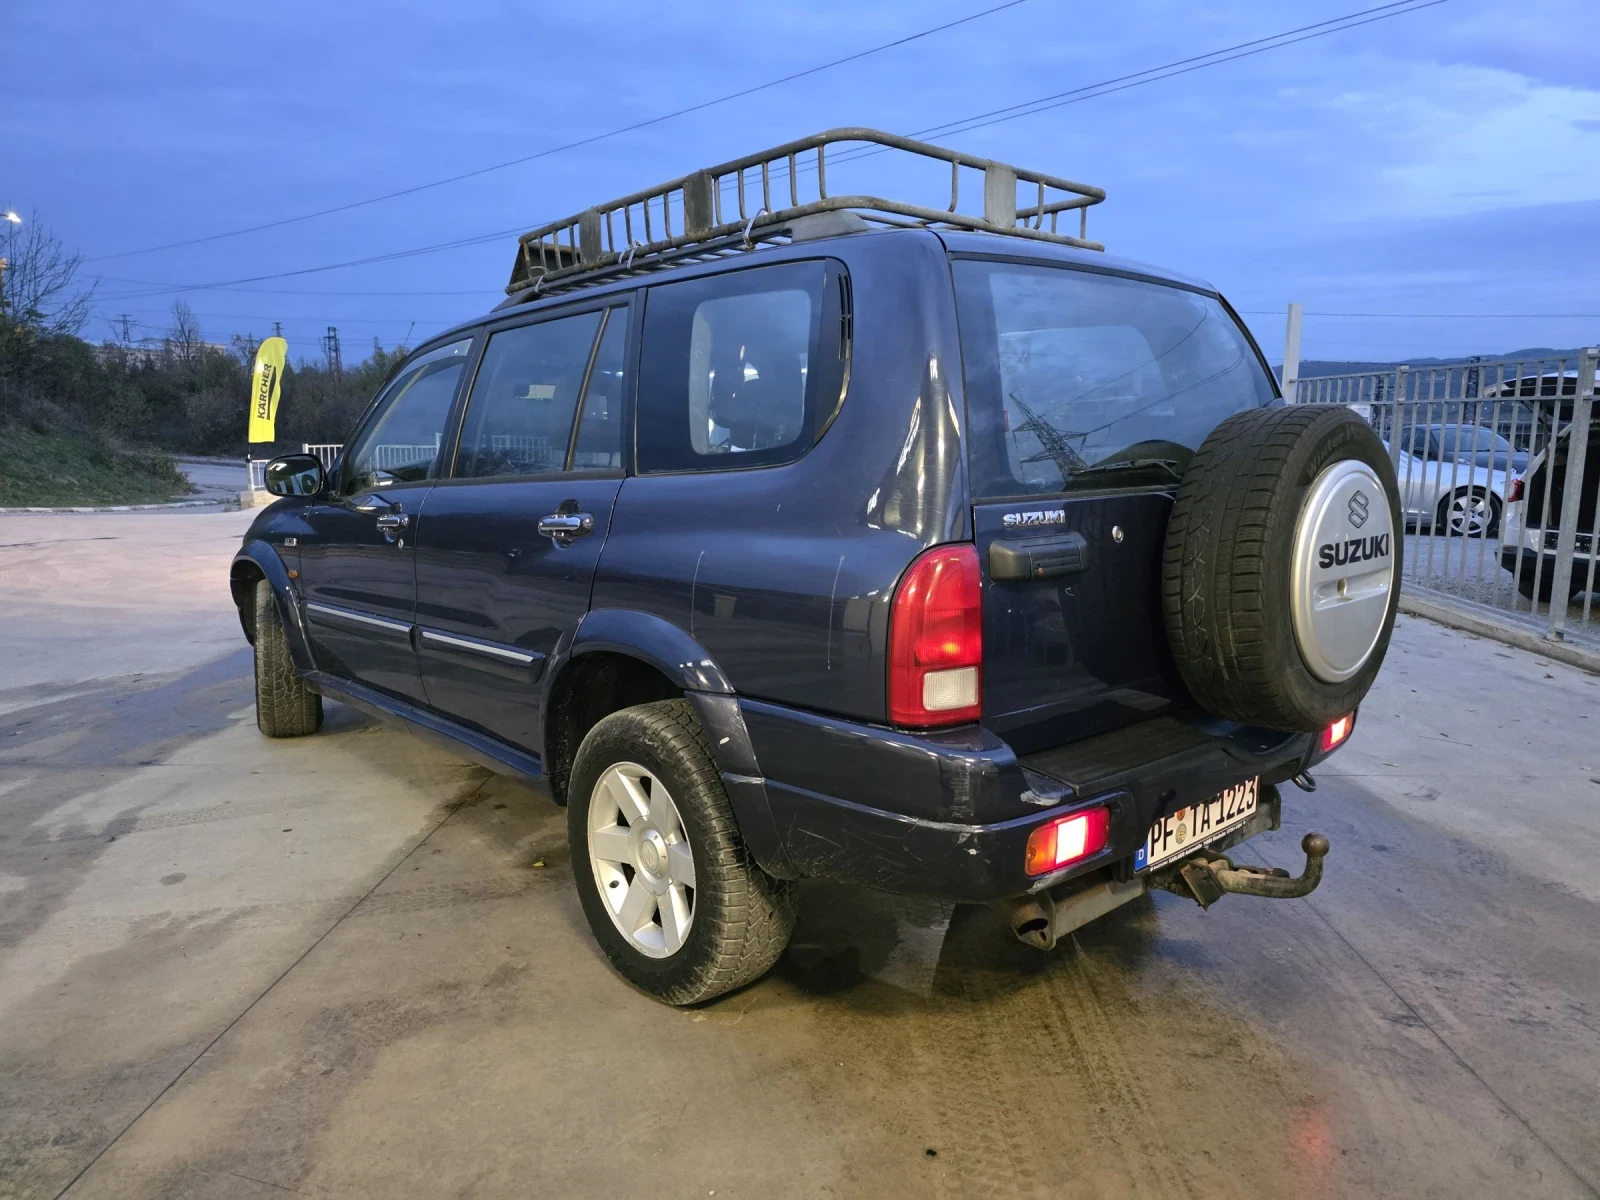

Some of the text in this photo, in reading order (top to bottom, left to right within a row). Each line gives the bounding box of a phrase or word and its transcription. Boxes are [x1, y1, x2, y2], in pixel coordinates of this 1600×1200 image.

[1003, 509, 1065, 527] SUZUKI
[1318, 532, 1389, 569] SUZUKI
[1150, 812, 1176, 858] PF
[1191, 800, 1211, 837] TA
[1216, 778, 1256, 825] 1223
[1138, 848, 1144, 860] D
